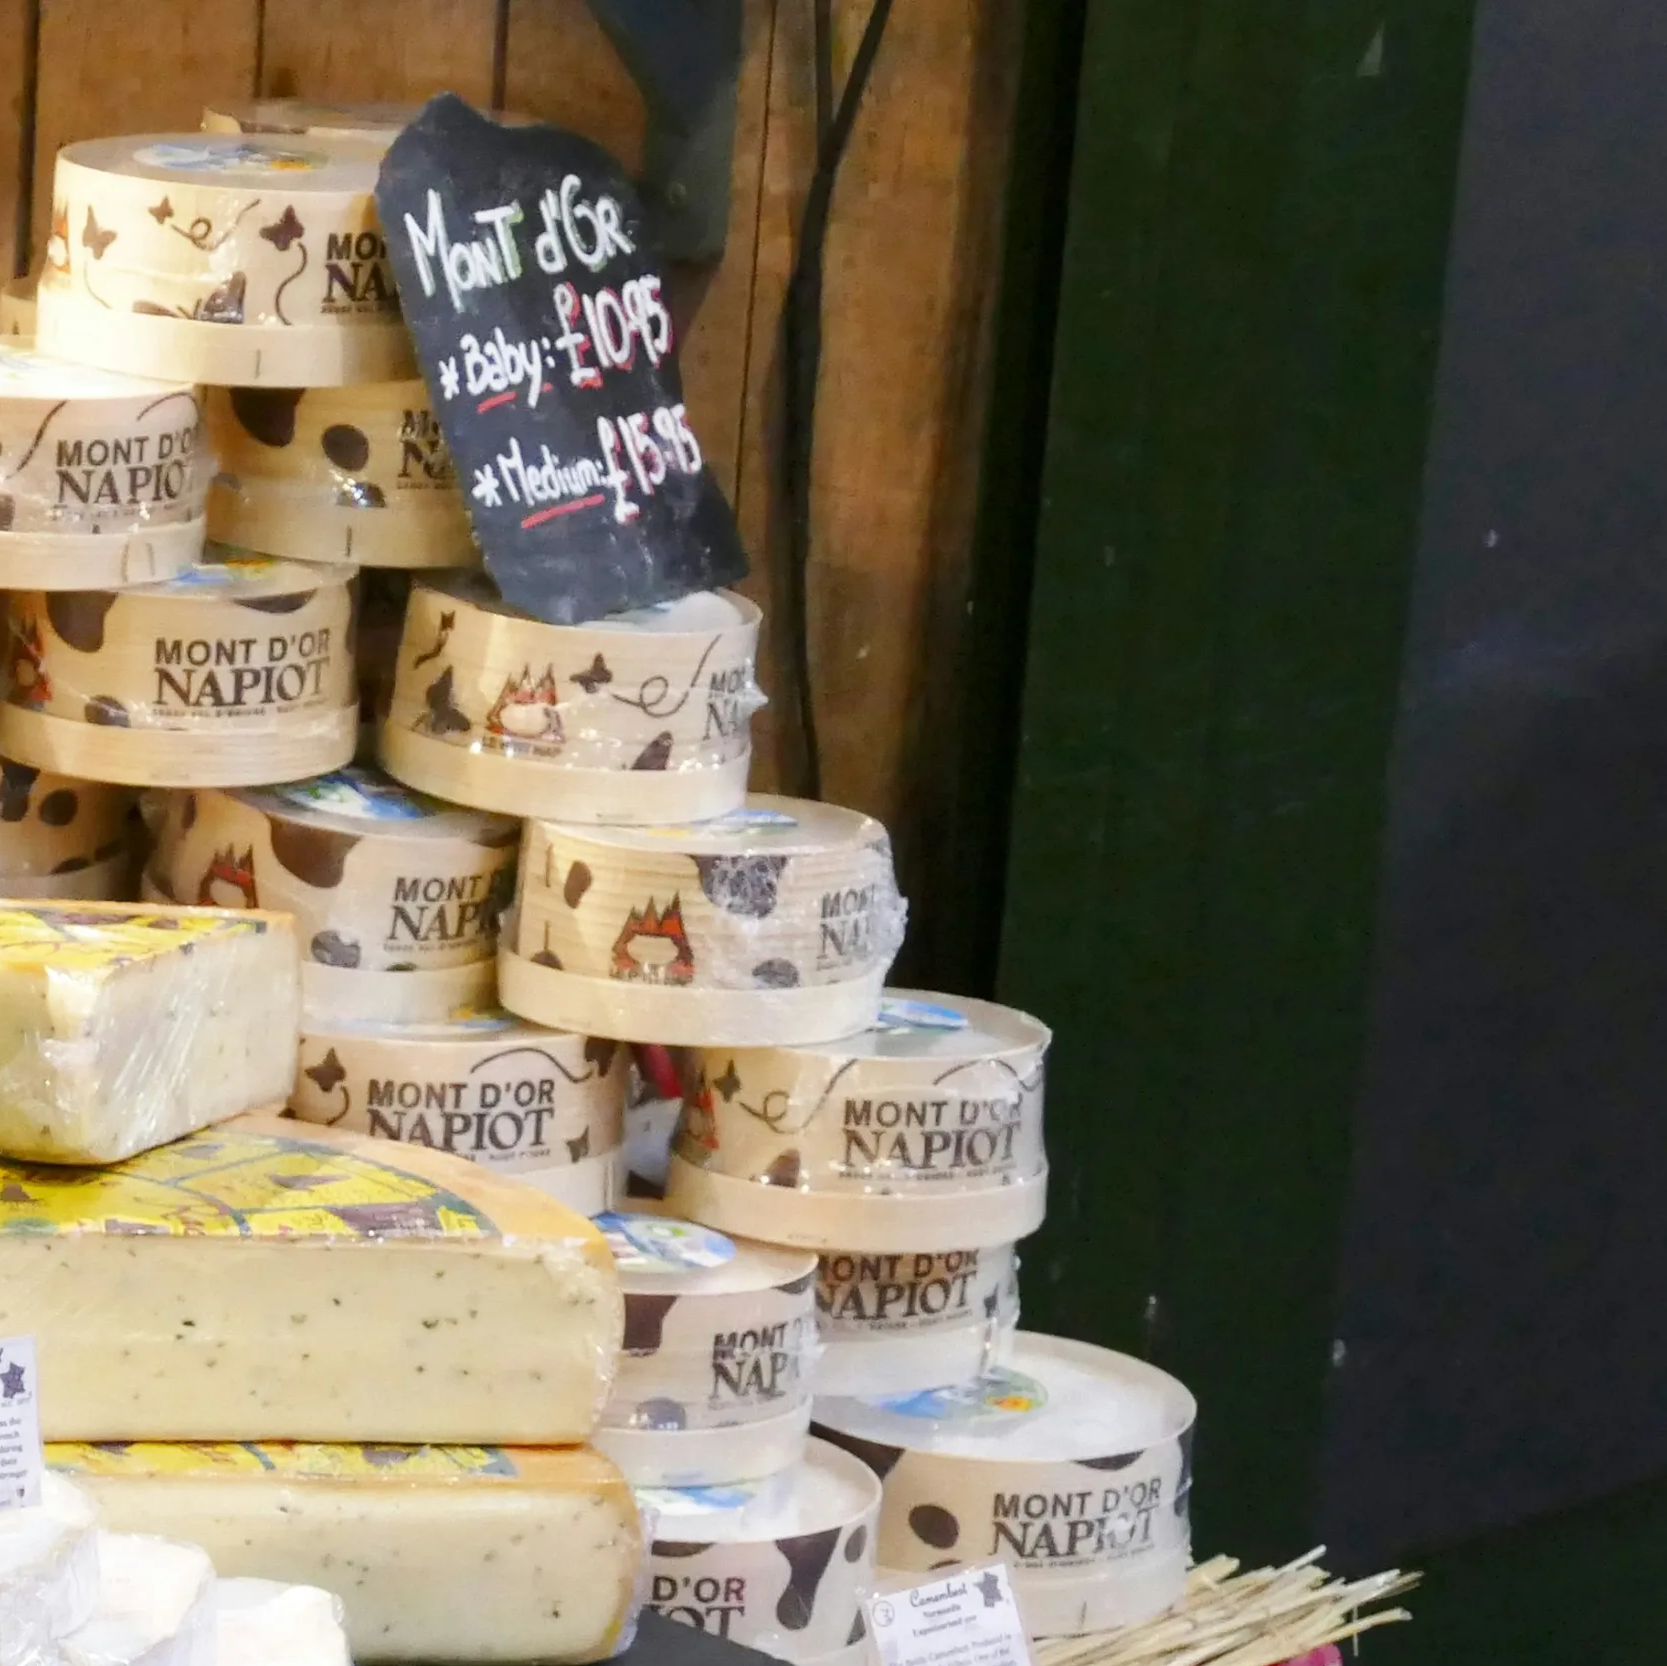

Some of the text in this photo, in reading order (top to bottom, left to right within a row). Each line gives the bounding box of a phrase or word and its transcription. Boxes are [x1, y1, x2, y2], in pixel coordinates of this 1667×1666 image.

[56, 436, 149, 468] MONT
[155, 628, 331, 667] MONT D'OR
[152, 656, 331, 708] NAPIOT
[368, 1078, 556, 1111] MONT D'OR
[843, 1098, 948, 1129] MONT
[368, 1106, 555, 1155] NAPIOT
[841, 1121, 1022, 1171] NAPIOT
[712, 1322, 787, 1362] MONT
[993, 1478, 1163, 1521] MONT D'OR
[992, 1503, 1160, 1560] NAPIOT
[651, 1575, 747, 1604] D'OR
